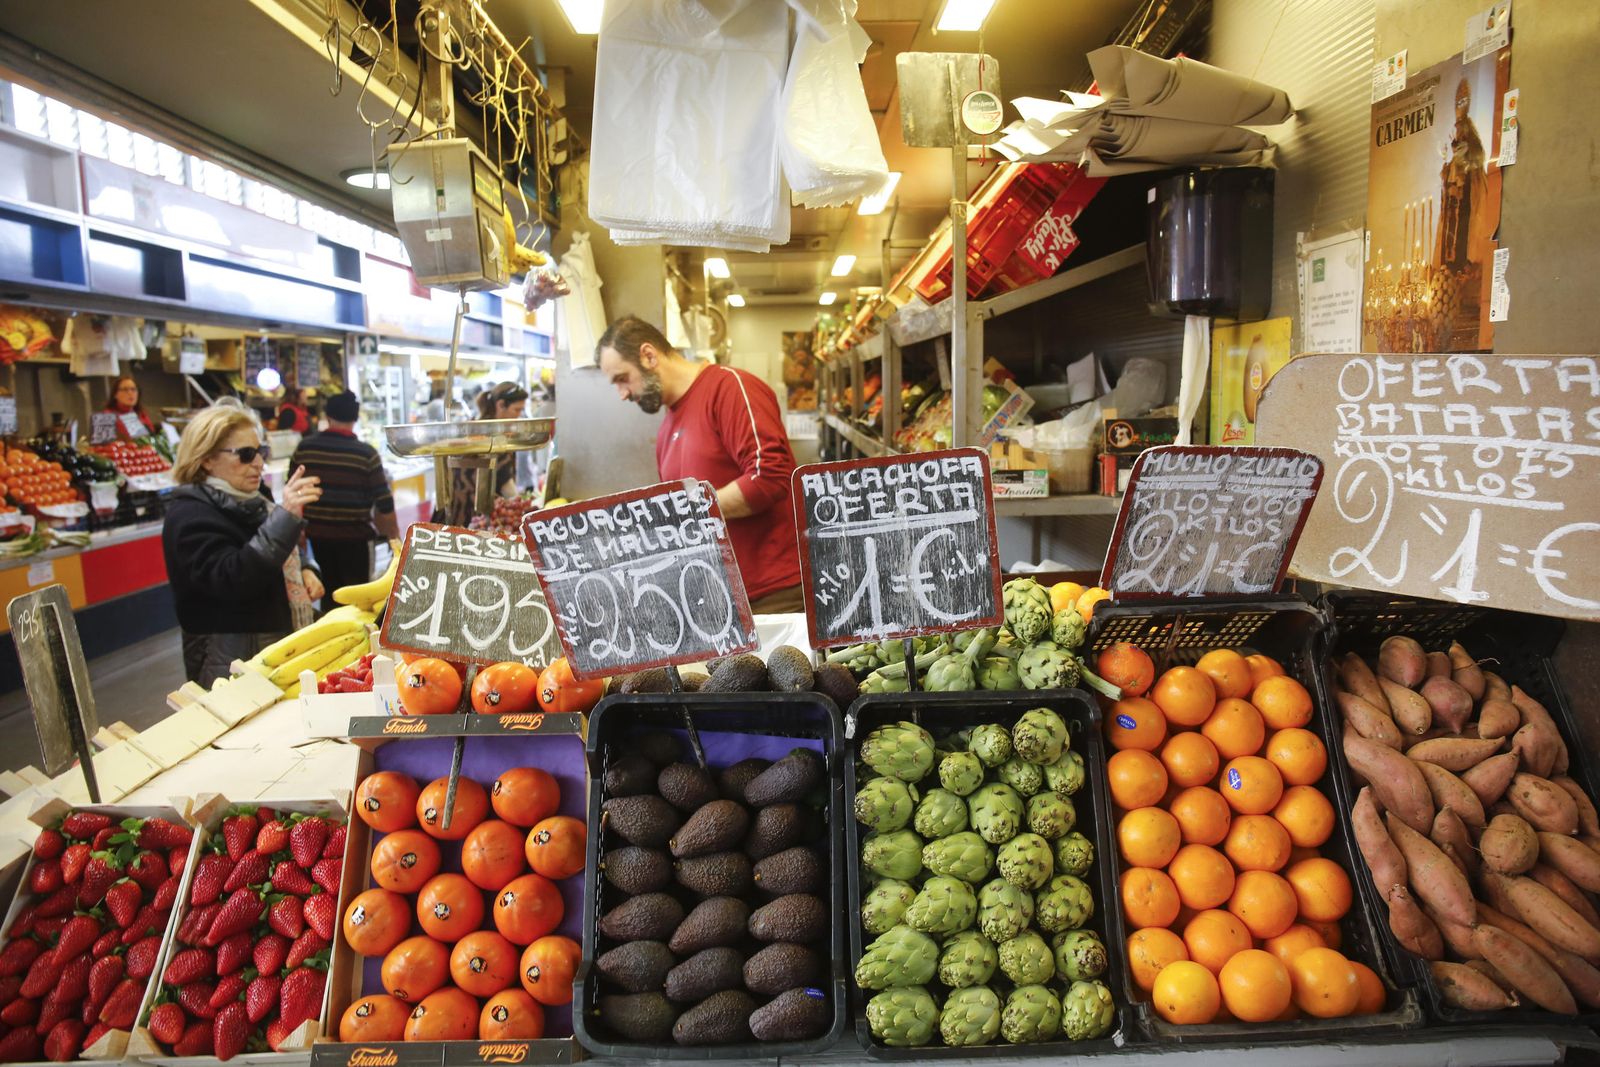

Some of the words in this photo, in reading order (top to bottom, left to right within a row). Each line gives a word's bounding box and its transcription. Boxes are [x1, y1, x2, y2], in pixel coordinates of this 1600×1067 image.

[1376, 103, 1436, 148] CARMEN
[1022, 207, 1061, 260] Lady
[1045, 208, 1081, 271] Pink
[1337, 355, 1600, 401] OFERTA
[1222, 423, 1247, 442] Zespri
[1336, 402, 1600, 442] BATATAS
[801, 456, 984, 496] ALCACHOFA
[1141, 452, 1232, 475] MUCHO
[1237, 456, 1319, 478] ZUMO
[529, 487, 713, 543] AGUACATES
[814, 482, 976, 525] OFERTA
[536, 544, 592, 575] DE
[394, 574, 431, 603] kilo
[18, 602, 40, 643] 295
[382, 717, 428, 735] Franda
[499, 711, 545, 731] Franda
[347, 1047, 399, 1067] Franda
[478, 1043, 530, 1064] Franda
